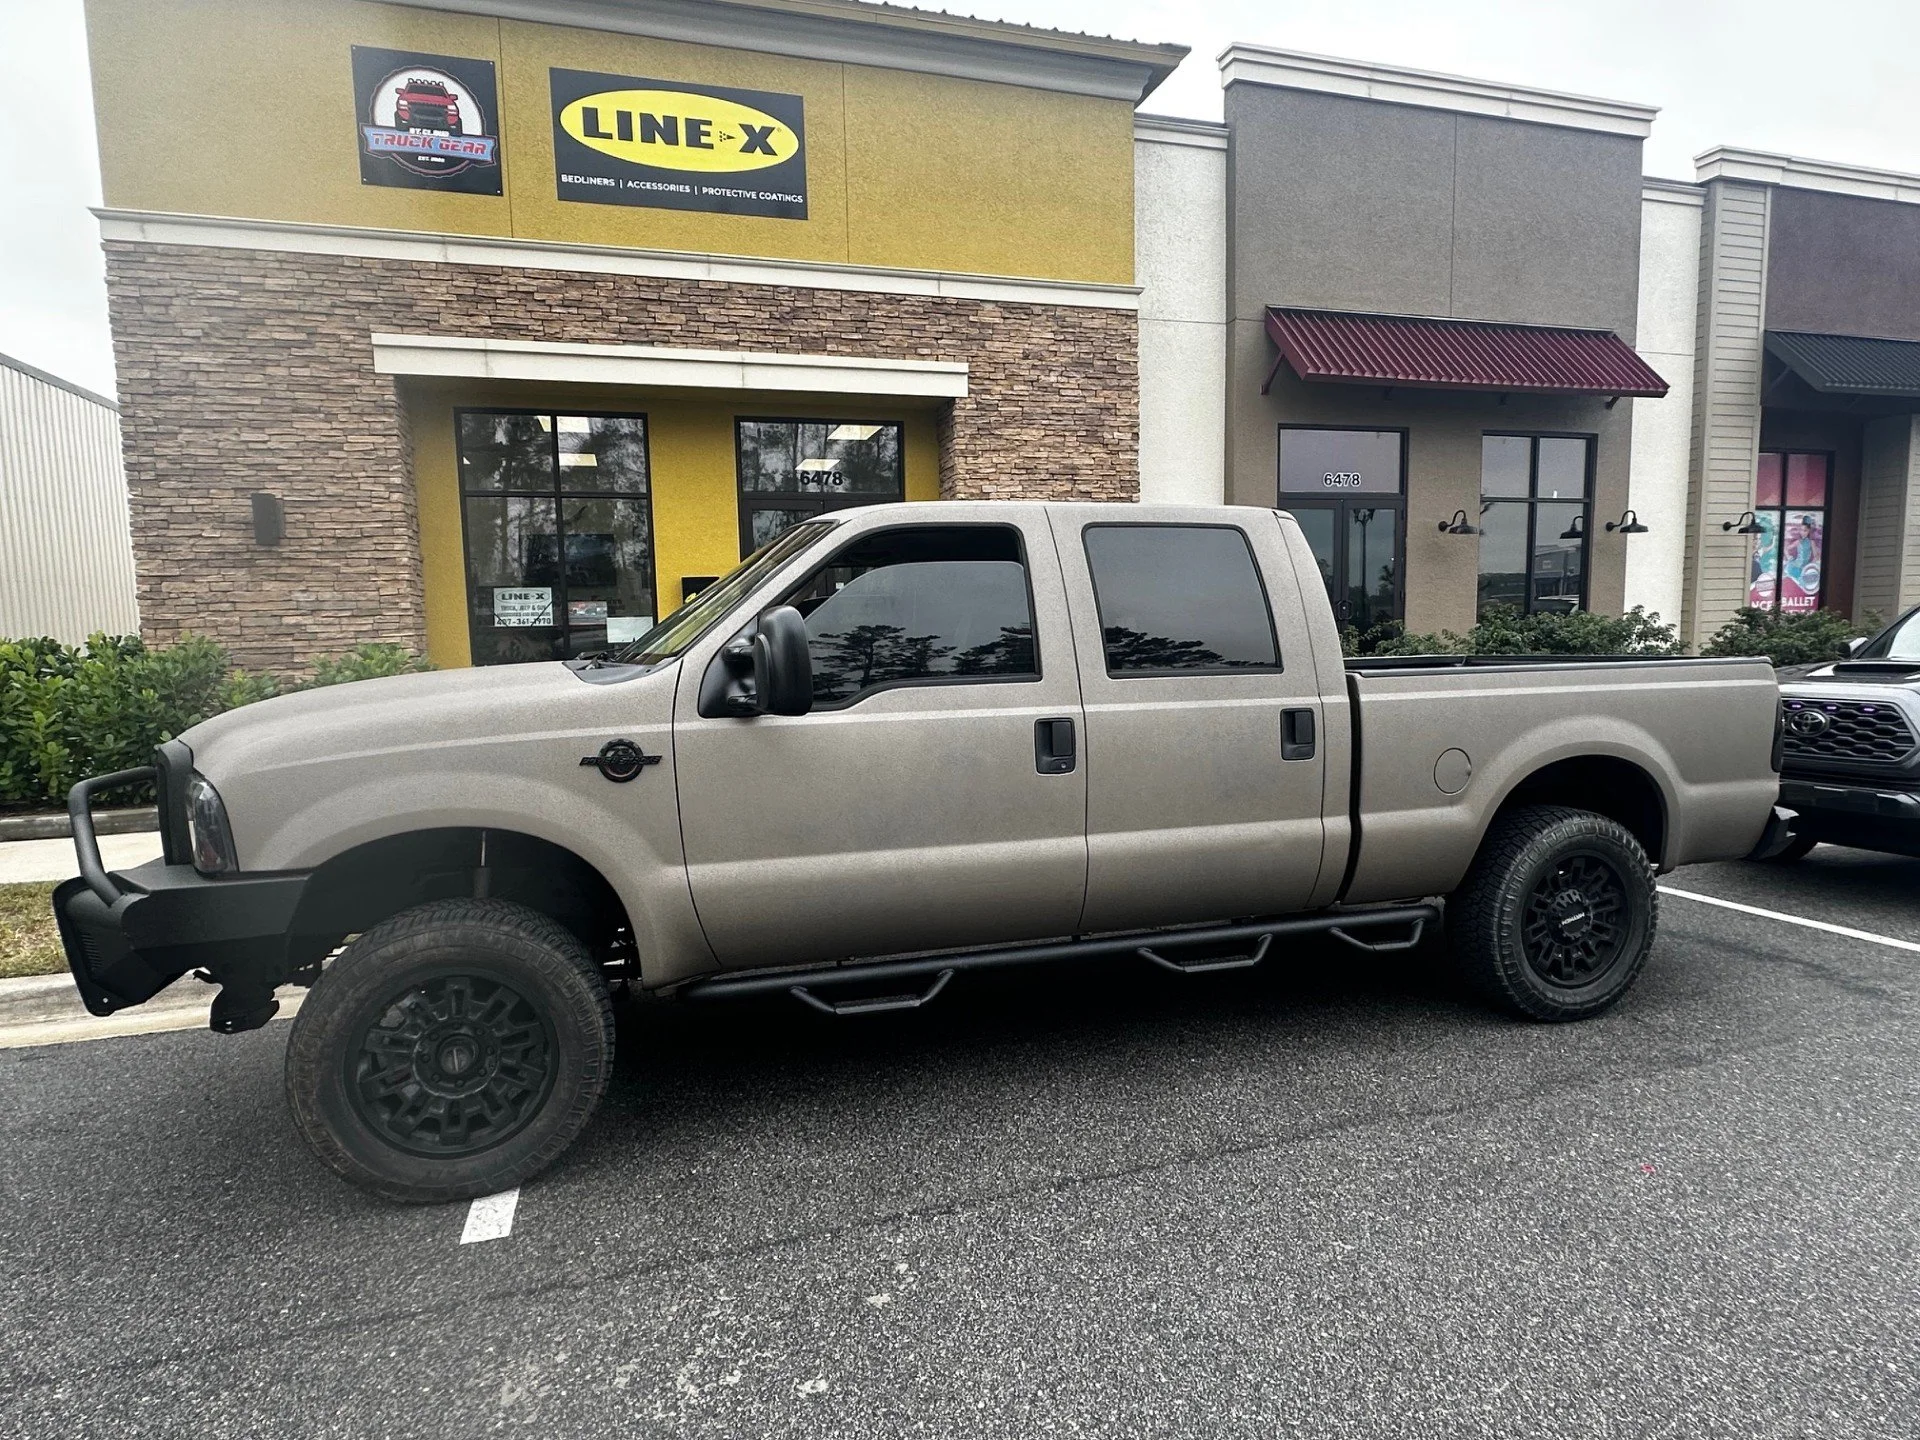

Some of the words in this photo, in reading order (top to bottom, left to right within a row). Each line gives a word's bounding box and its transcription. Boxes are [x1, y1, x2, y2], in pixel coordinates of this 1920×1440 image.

[372, 133, 434, 149] TRUCK
[438, 137, 487, 155] GEAR
[560, 174, 615, 187] BEDLINERS
[626, 180, 690, 193] ACCESSORIES
[702, 186, 757, 199] PROTECTIVE
[758, 191, 804, 204] COATINGS
[800, 470, 843, 486] 6478
[1323, 472, 1361, 488] 6478
[1751, 600, 1773, 612] NCE
[1781, 596, 1816, 607] BALLET
